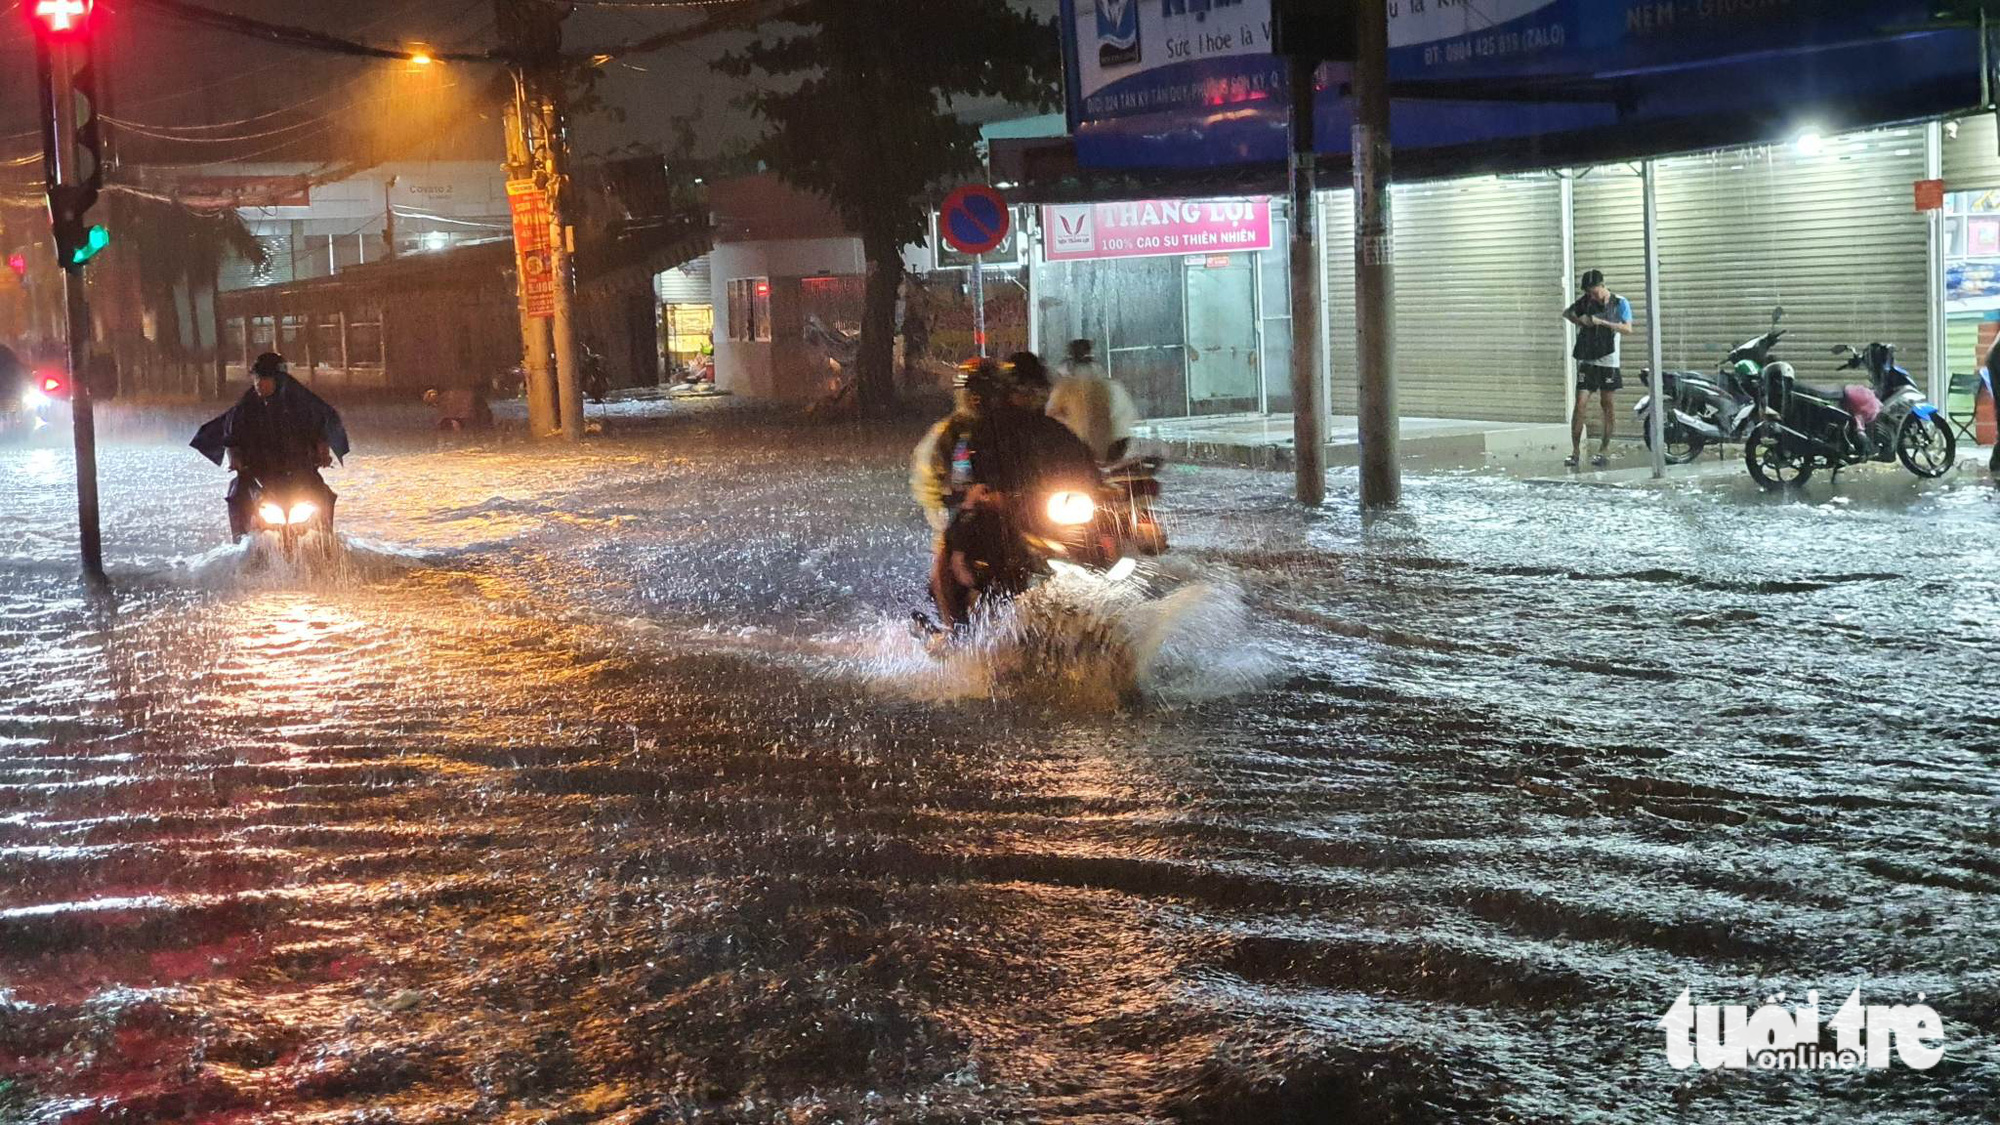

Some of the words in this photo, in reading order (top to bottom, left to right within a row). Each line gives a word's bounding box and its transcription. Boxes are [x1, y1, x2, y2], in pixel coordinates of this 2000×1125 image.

[1102, 237, 1133, 251] 100%
[1136, 235, 1160, 249] CAO
[1163, 234, 1179, 248] SU
[1182, 230, 1218, 246] THIÊN
[1220, 228, 1256, 244] NHIÊN
